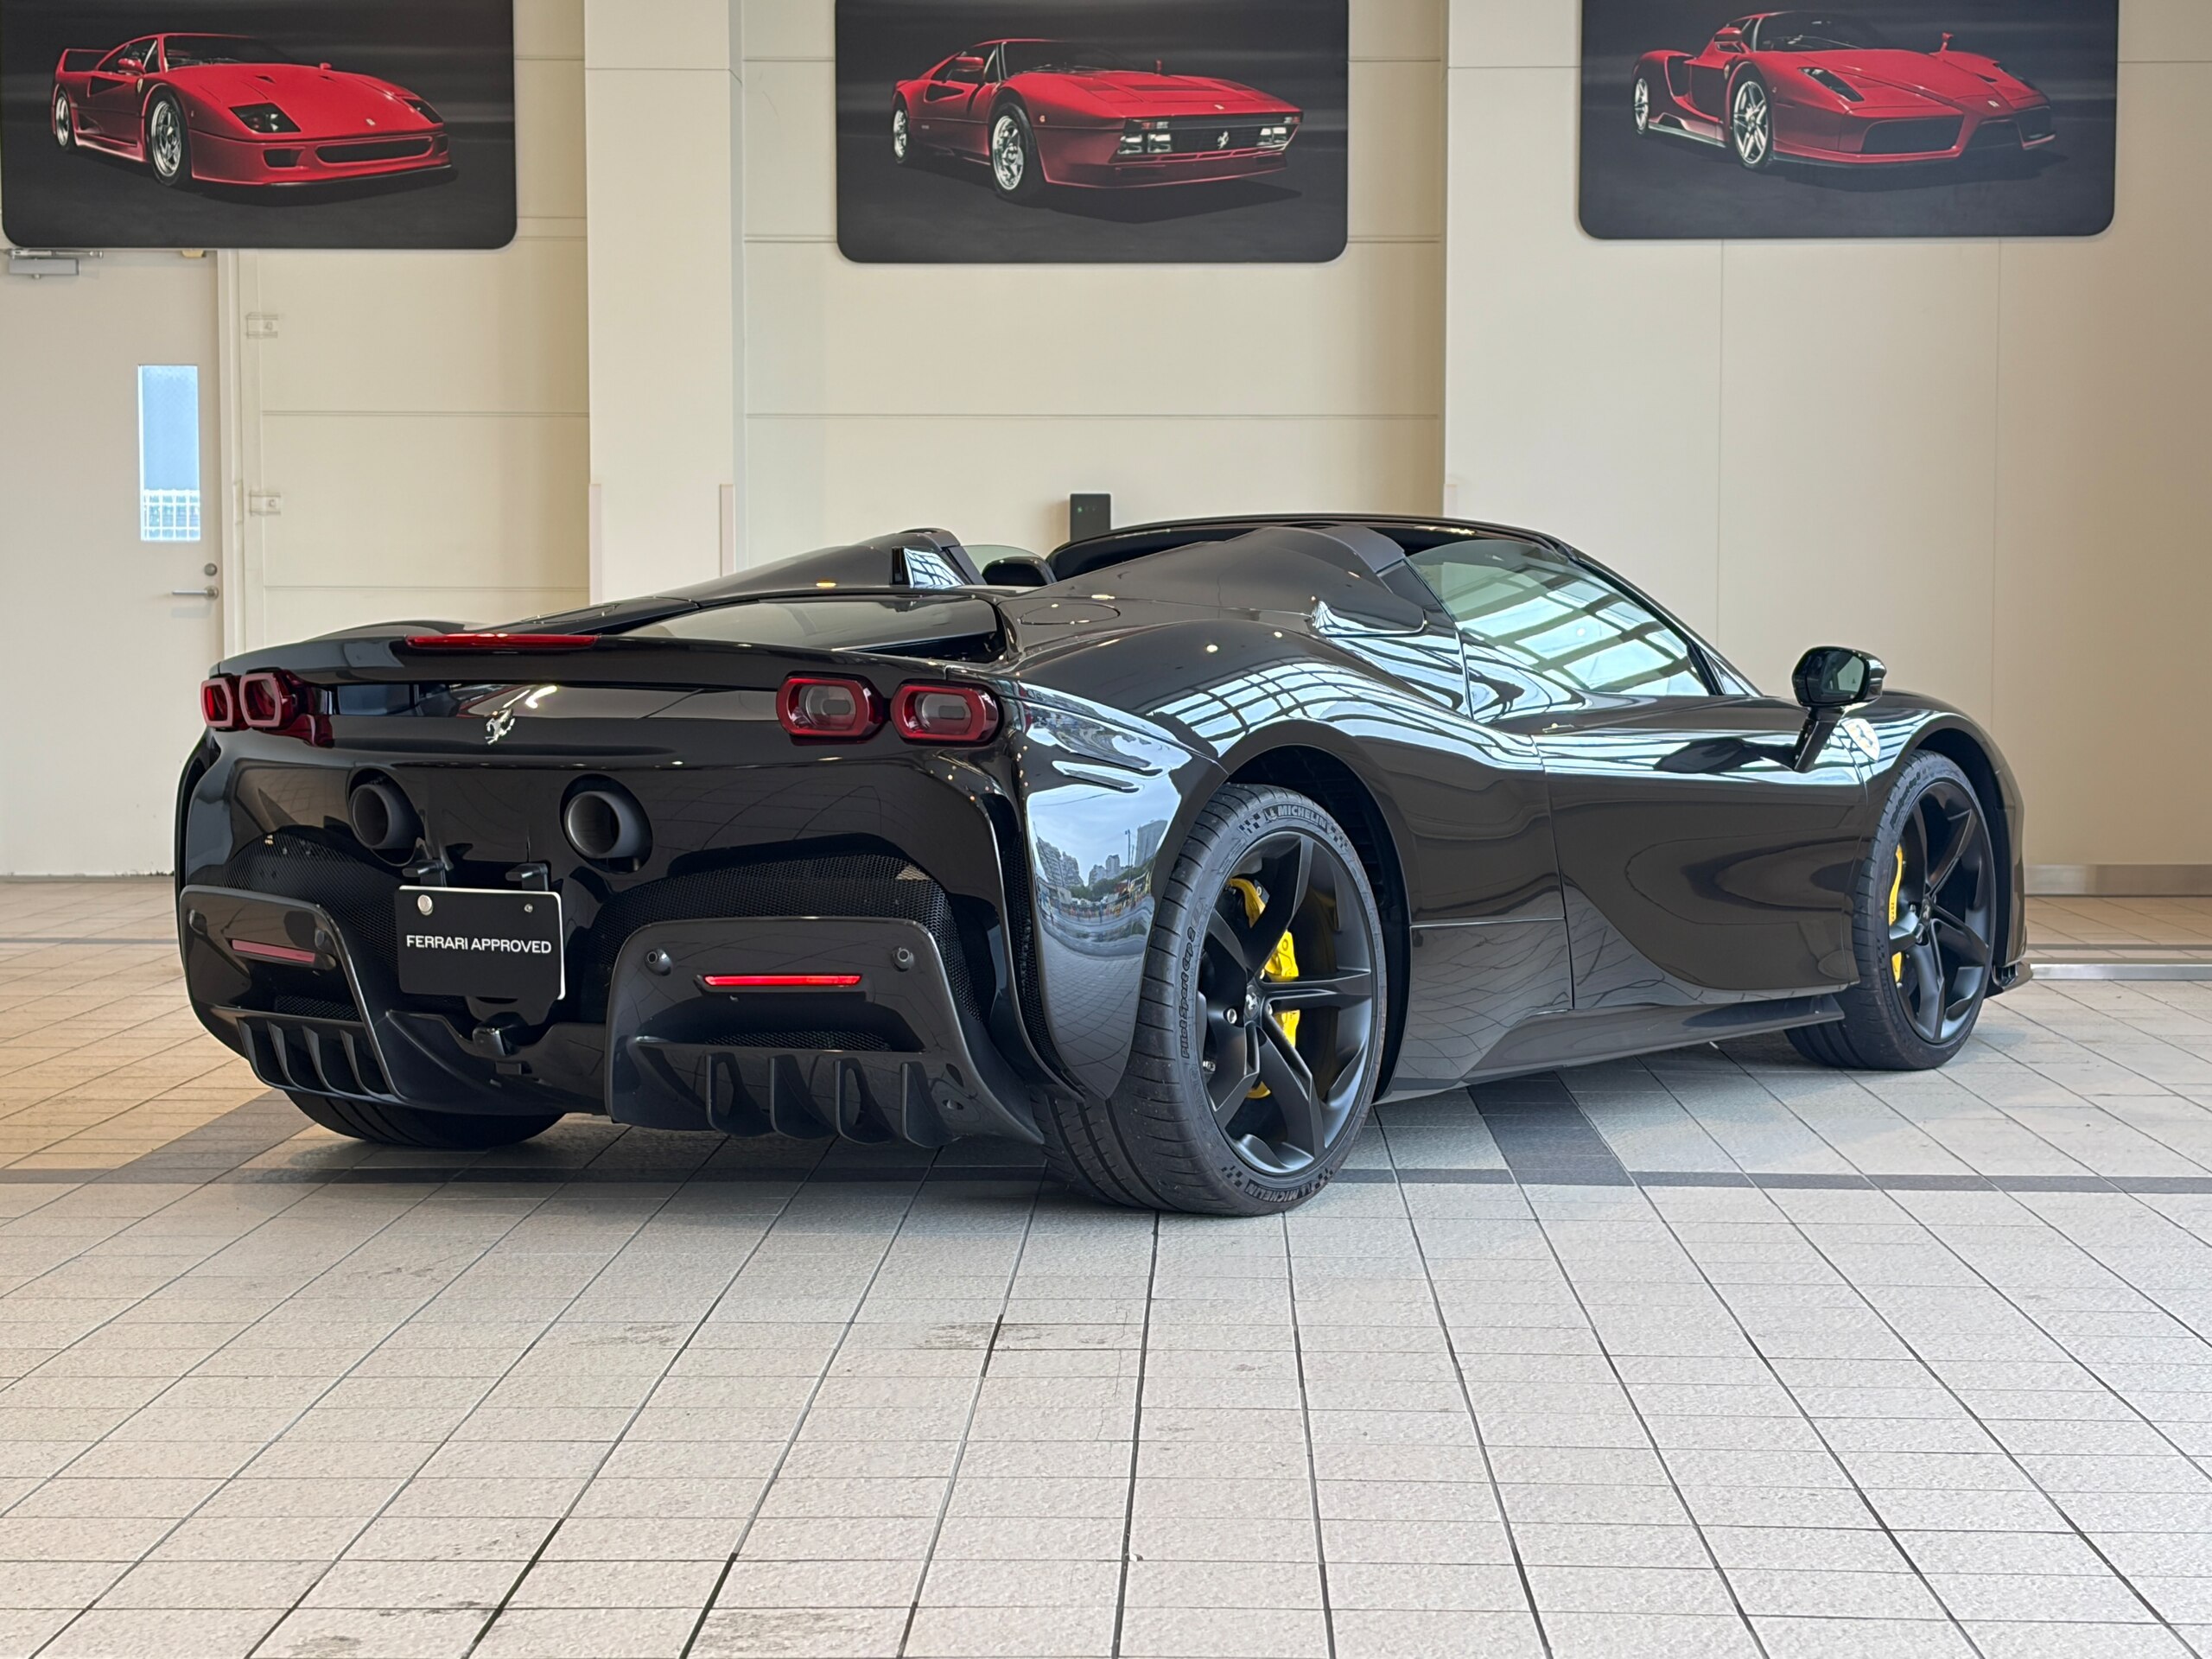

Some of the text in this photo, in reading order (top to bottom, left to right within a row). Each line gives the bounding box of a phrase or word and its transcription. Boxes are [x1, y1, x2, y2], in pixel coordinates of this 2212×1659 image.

[1278, 804, 1327, 829] MICHELIN
[406, 935, 551, 953] FERRARI APPROVED
[1179, 926, 1196, 1059] Pilot Sport Cup 2
[1245, 1184, 1300, 1202] MICHELIN
